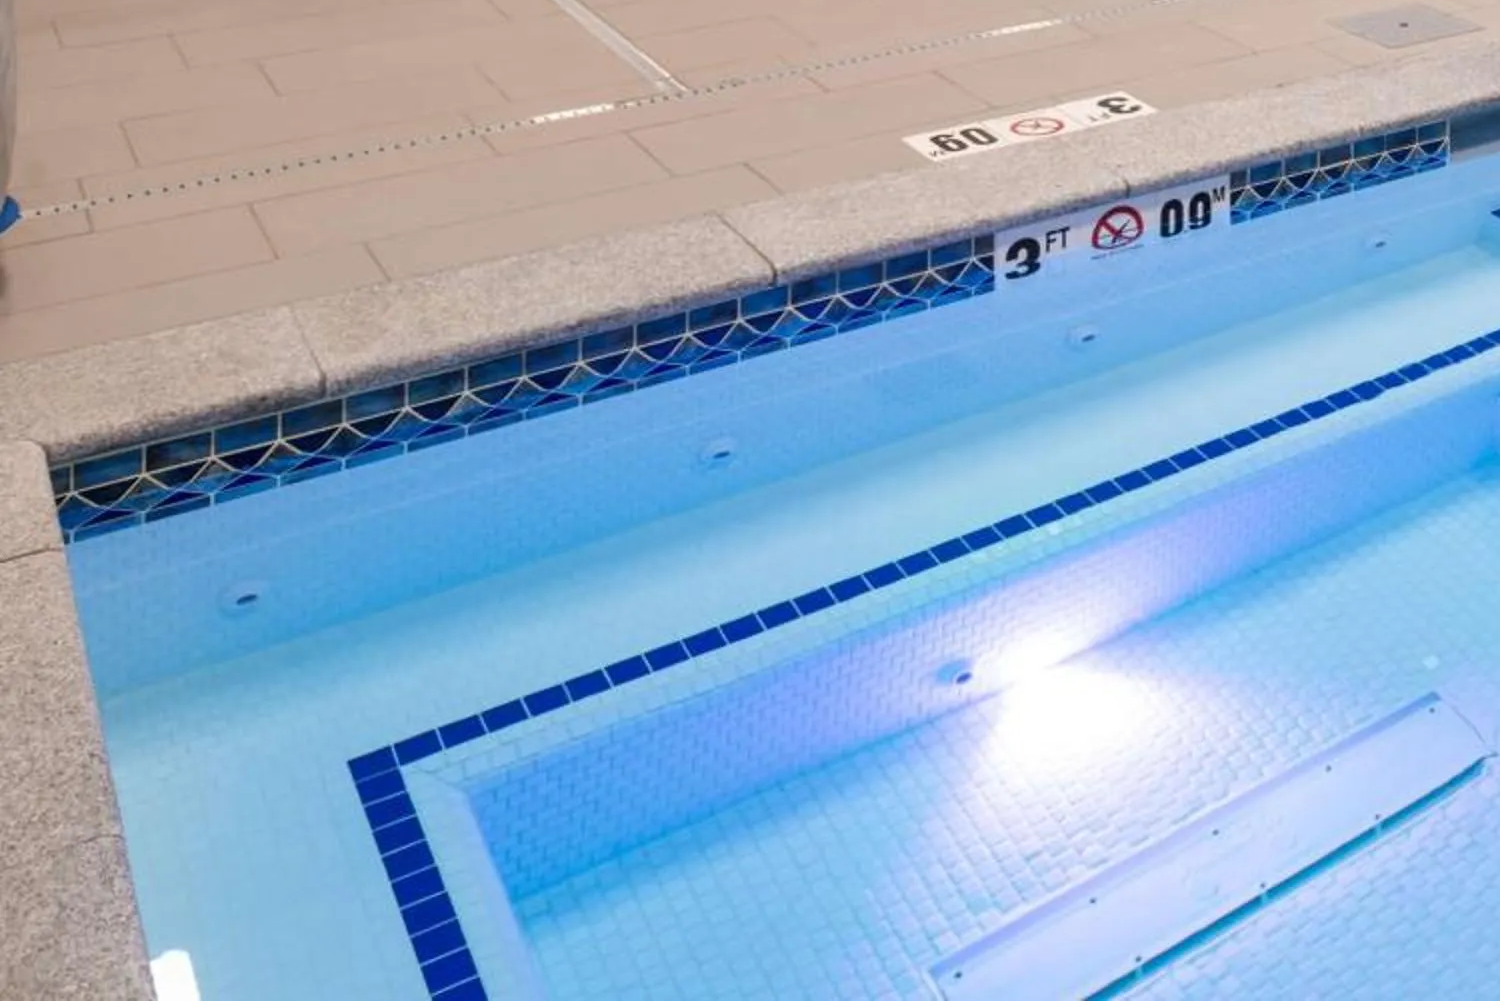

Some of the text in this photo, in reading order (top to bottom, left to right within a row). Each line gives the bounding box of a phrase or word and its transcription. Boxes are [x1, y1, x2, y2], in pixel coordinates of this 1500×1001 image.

[1097, 97, 1142, 115] 3
[1004, 237, 1041, 280] 3
[1045, 226, 1071, 253] FT
